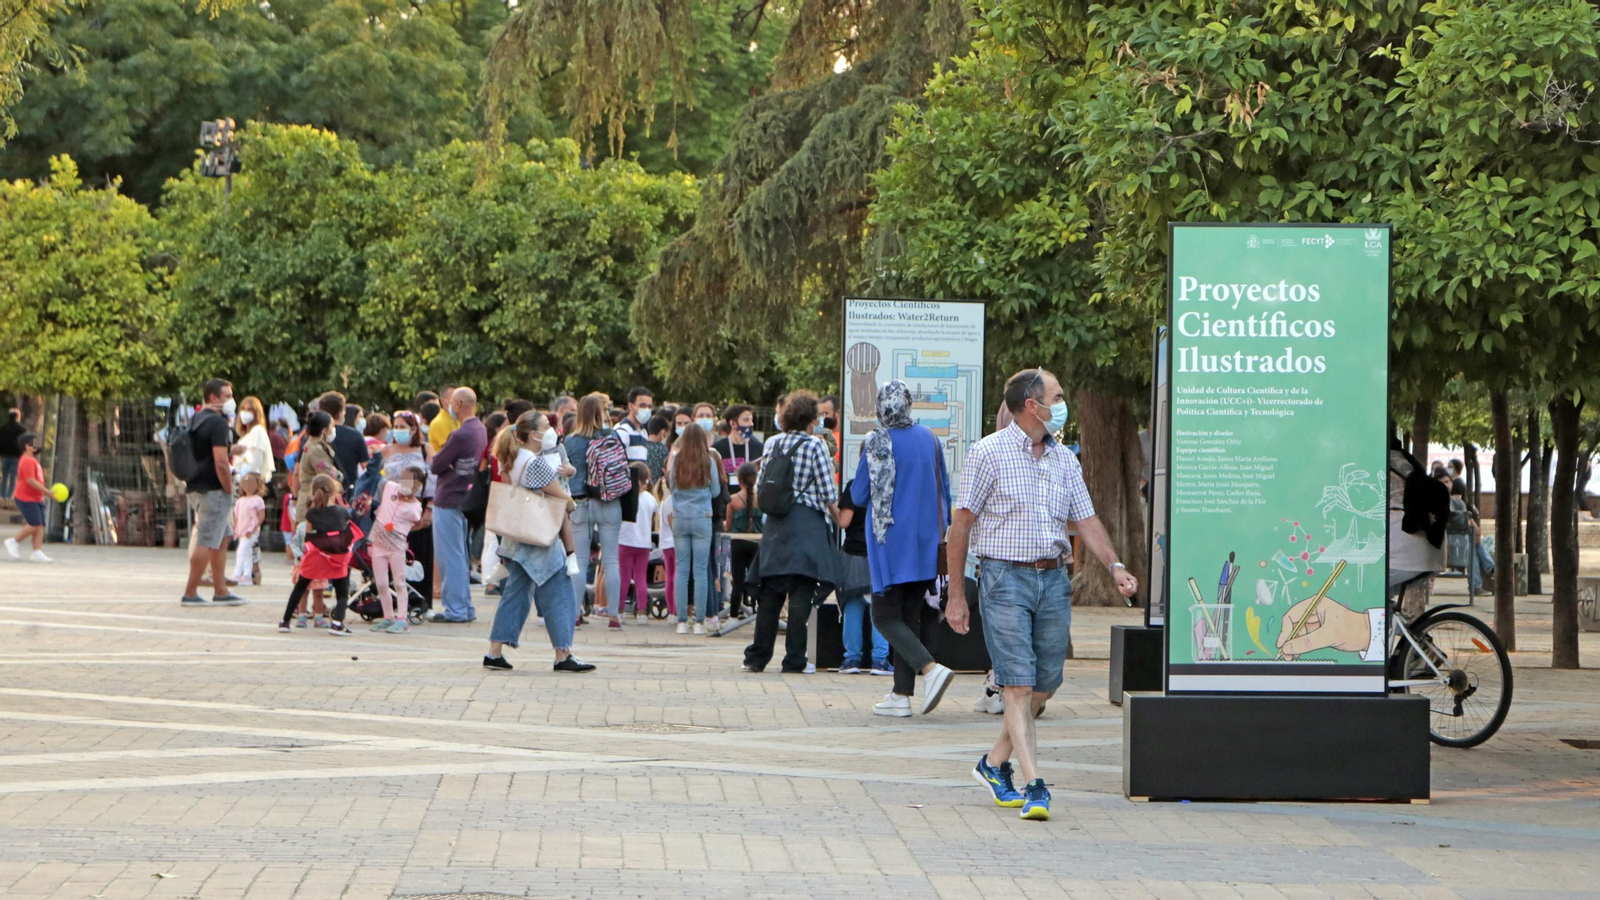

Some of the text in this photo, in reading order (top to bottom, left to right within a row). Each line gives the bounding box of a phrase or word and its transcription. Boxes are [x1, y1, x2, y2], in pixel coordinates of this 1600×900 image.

[1178, 276, 1320, 310] Proyectos
[849, 300, 891, 310] Proyectos
[848, 311, 959, 322] Ilustrados: Water2Return
[1178, 311, 1336, 338] Científicos
[1178, 346, 1326, 373] Ilustrados
[1251, 408, 1294, 417] Tecnológica
